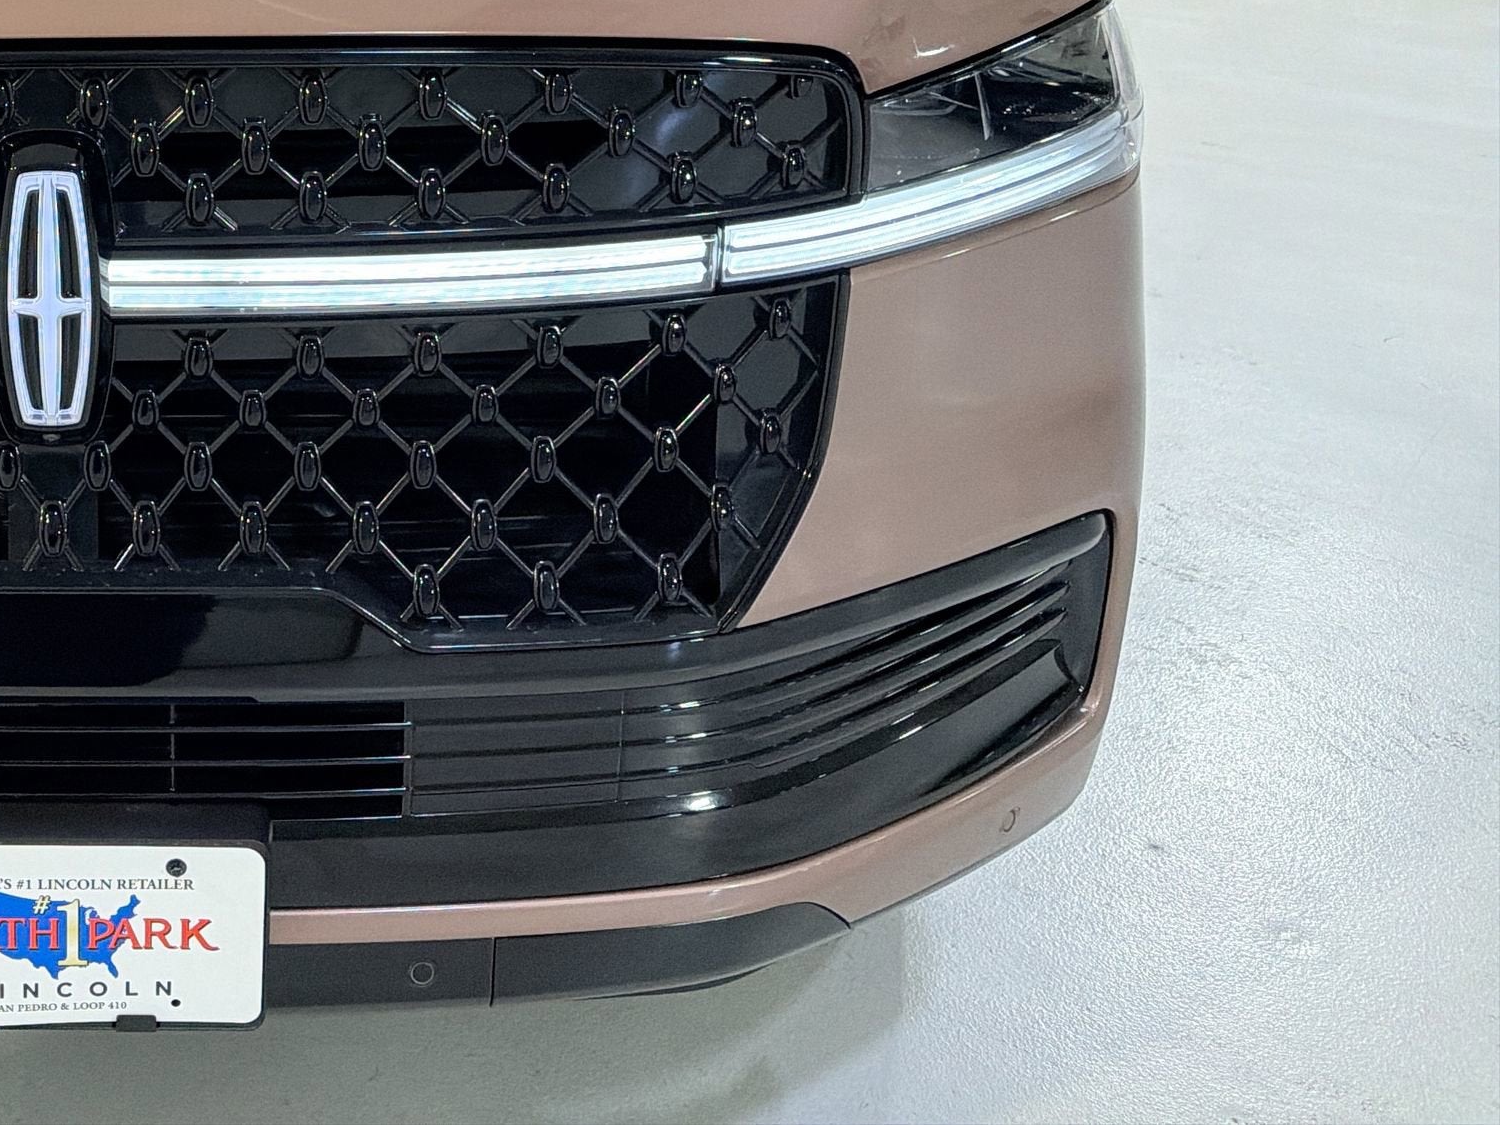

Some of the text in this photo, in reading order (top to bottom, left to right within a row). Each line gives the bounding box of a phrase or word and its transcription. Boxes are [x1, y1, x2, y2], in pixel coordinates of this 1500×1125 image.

[16, 878, 32, 890] #1
[37, 878, 112, 891] LINCOLN
[116, 878, 195, 891] RETAILER
[86, 917, 221, 952] PARK
[17, 1003, 58, 1013] PEDRO
[60, 1003, 69, 1011] &
[73, 1001, 106, 1011] LOOP
[107, 1000, 128, 1010] 410
